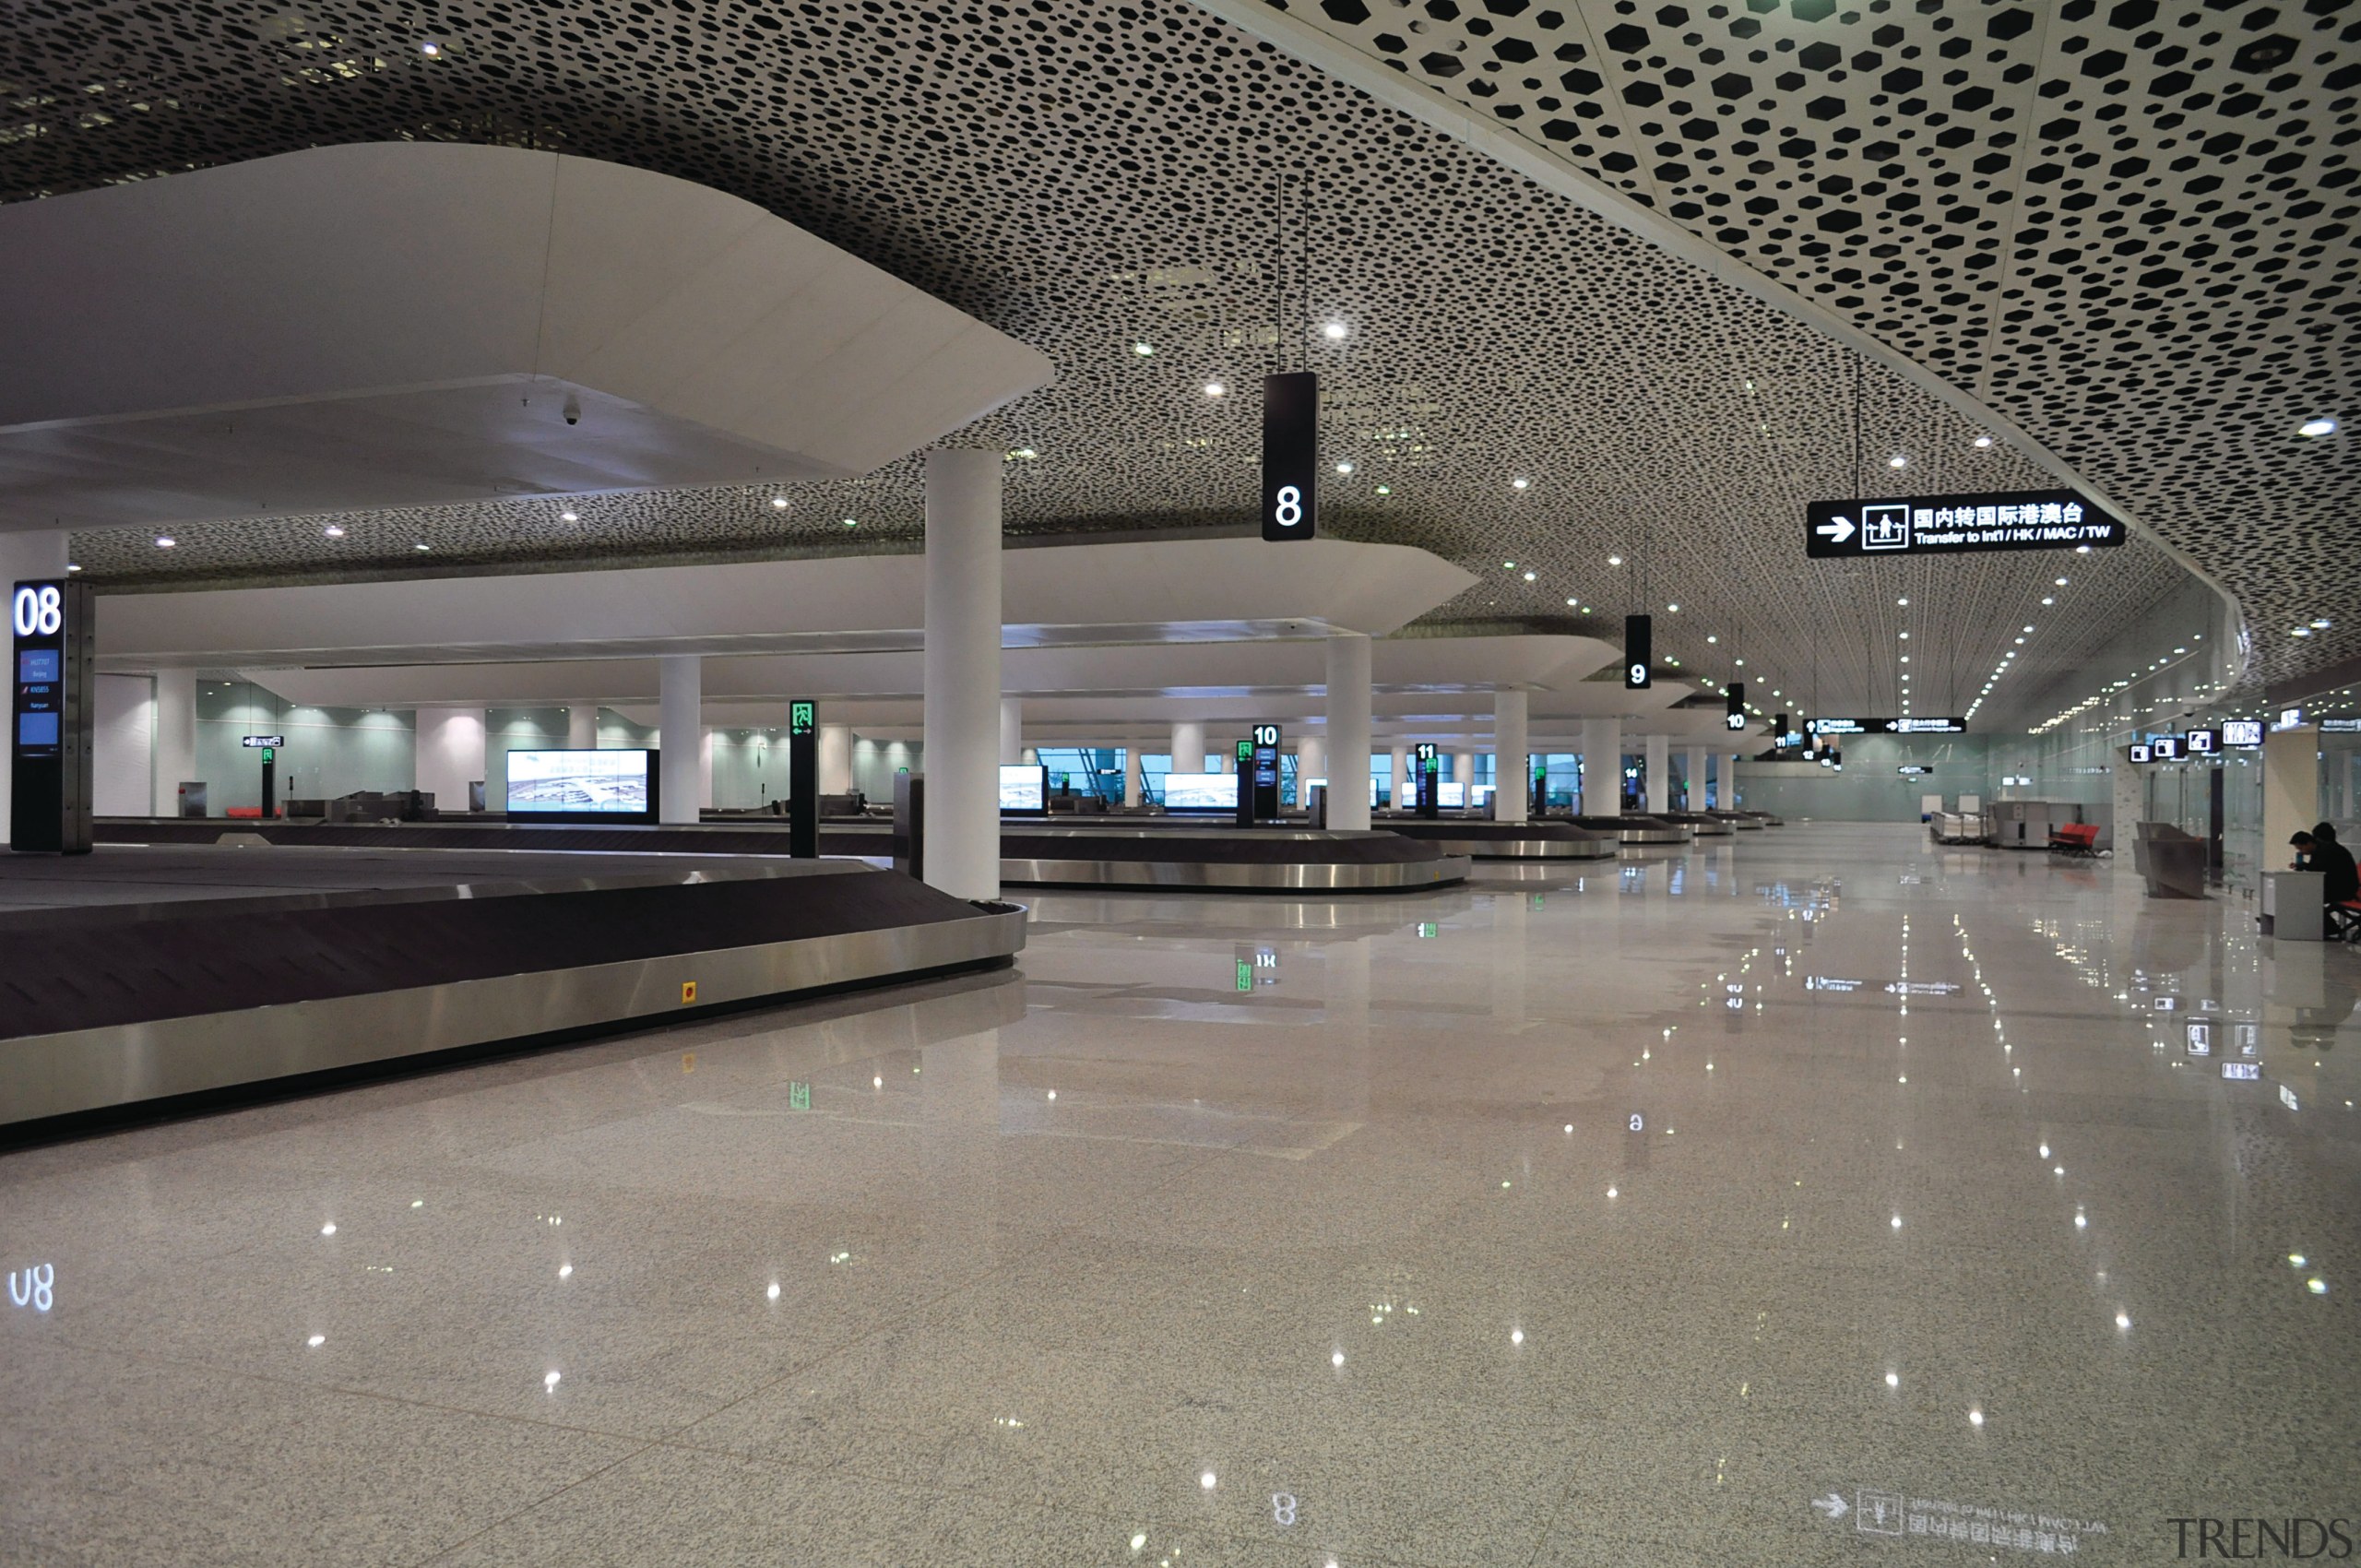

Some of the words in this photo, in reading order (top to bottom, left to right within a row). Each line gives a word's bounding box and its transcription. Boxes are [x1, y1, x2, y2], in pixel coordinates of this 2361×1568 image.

[1275, 485, 1302, 527] 8
[1914, 503, 2082, 529] 国内转国际港澳台
[1915, 530, 1965, 545] Transfer
[1967, 530, 1980, 543] to
[2013, 528, 2035, 541] HK
[2044, 526, 2077, 540] MAC
[2086, 525, 2111, 539] TW
[15, 587, 61, 636] 08
[1631, 664, 1645, 683] 9
[1727, 714, 1745, 729] 10
[1254, 726, 1277, 745] 10
[1775, 737, 1786, 748] 11
[1418, 744, 1433, 759] 11
[1802, 750, 1814, 760] 12
[1625, 767, 1638, 778] 14
